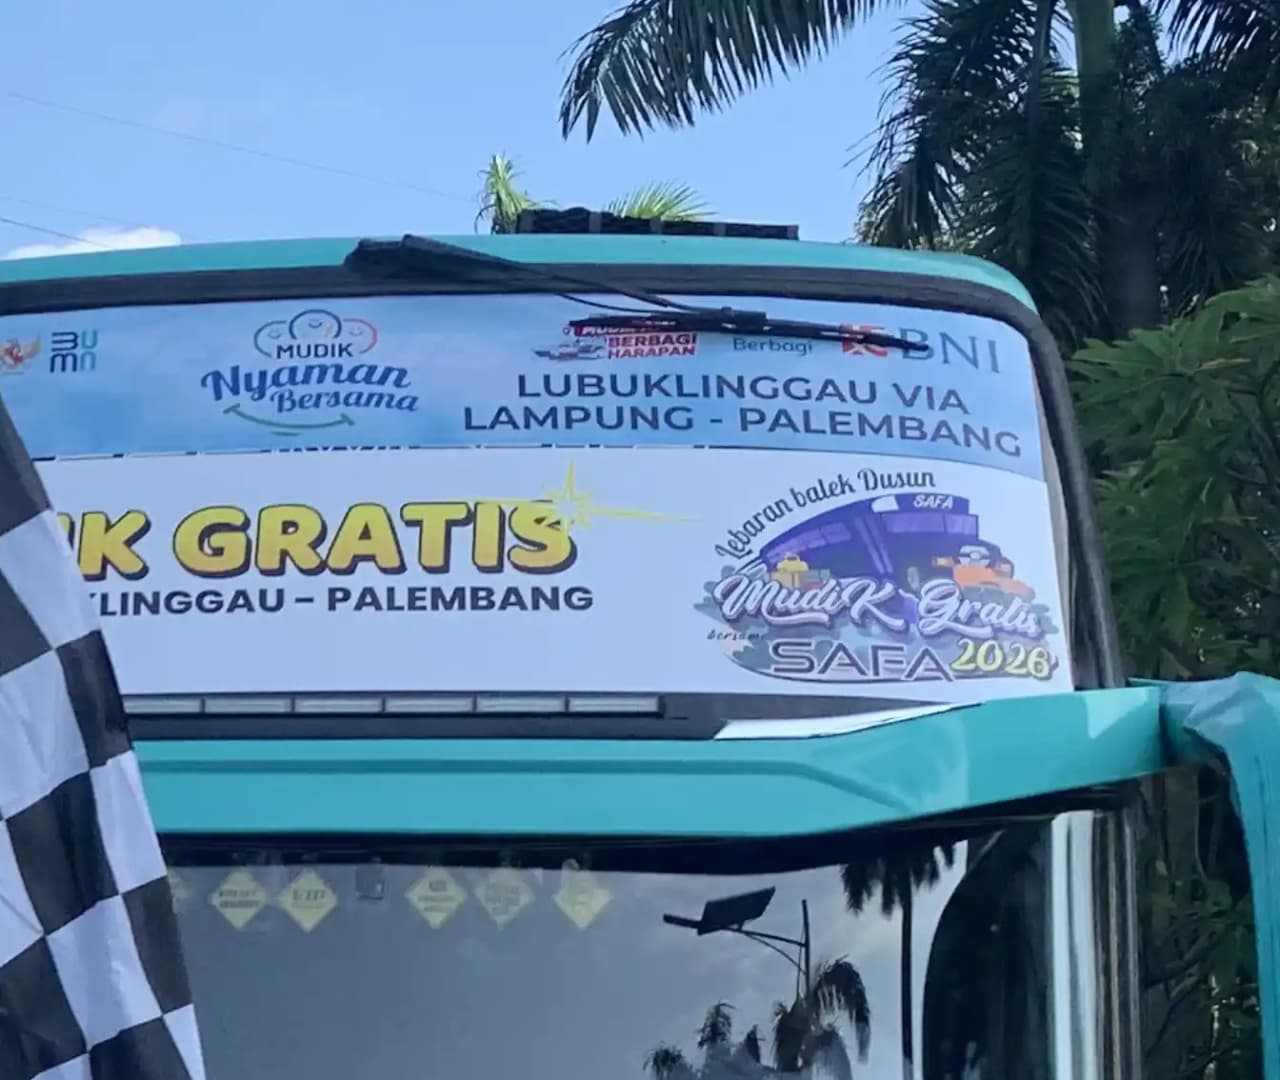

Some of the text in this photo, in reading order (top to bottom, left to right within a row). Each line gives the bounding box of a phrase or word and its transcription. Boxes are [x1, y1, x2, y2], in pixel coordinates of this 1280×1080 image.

[275, 342, 354, 360] MUDIK
[607, 332, 698, 348] BERBAGI
[607, 344, 696, 361] HARAPAN
[732, 337, 814, 357] Berbagi
[898, 327, 1001, 374] BNI
[200, 362, 412, 401] Nyaman
[270, 386, 419, 414] Bersama
[517, 373, 970, 415] LUBUKLINGGAU VIA
[463, 406, 695, 431] LAMPUNG
[739, 406, 1022, 457] PALEMBANG
[714, 467, 936, 560] Lebaran balek Dusun
[913, 494, 954, 509] SAFA
[172, 500, 578, 579] GRATIS
[327, 586, 593, 611] PALEMBANG
[918, 578, 1042, 640] Gratis
[770, 638, 1059, 682] SAFA 2026
